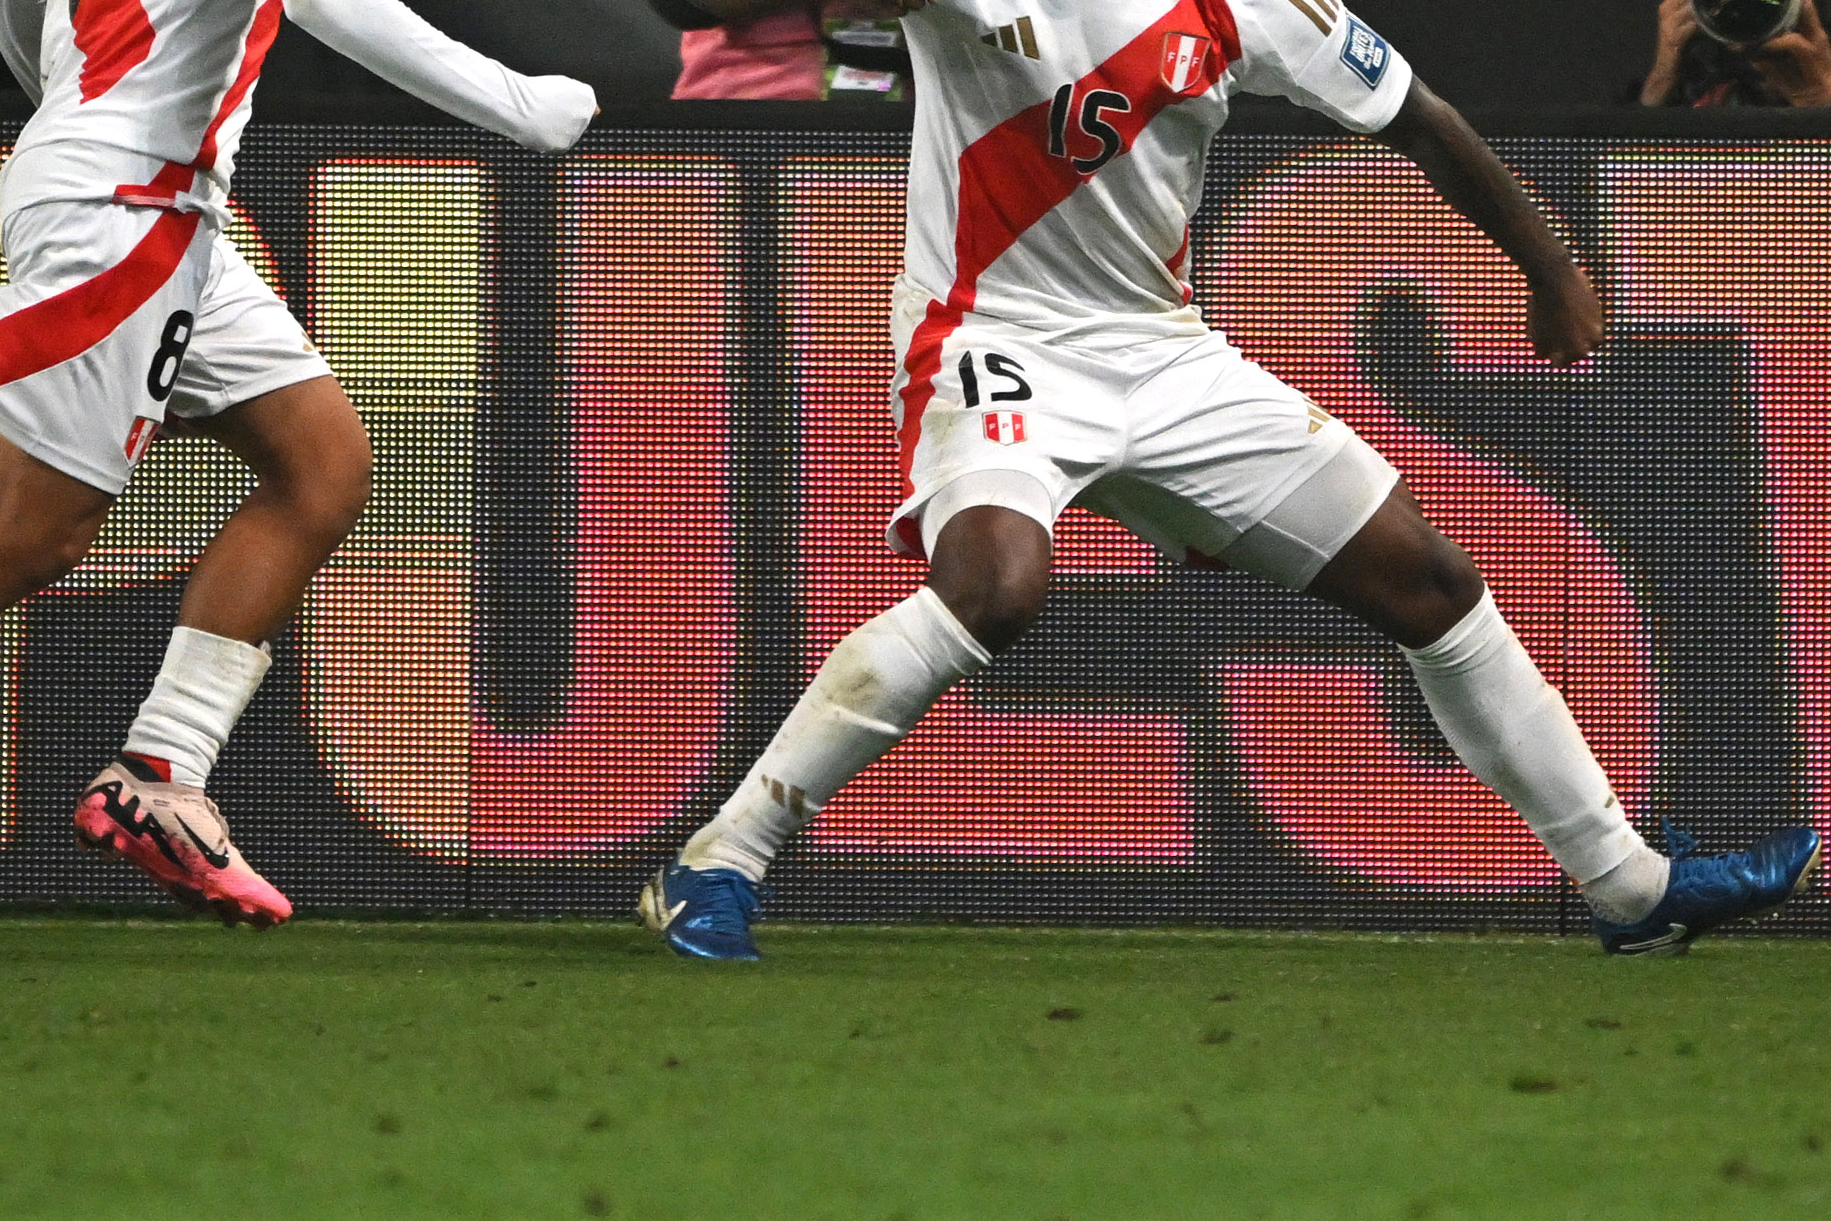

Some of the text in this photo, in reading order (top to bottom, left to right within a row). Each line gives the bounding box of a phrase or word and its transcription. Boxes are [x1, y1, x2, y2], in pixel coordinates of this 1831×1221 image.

[1166, 51, 1201, 68] FPF
[1048, 83, 1131, 176] 15
[147, 309, 194, 402] 8
[958, 350, 1033, 409] 15
